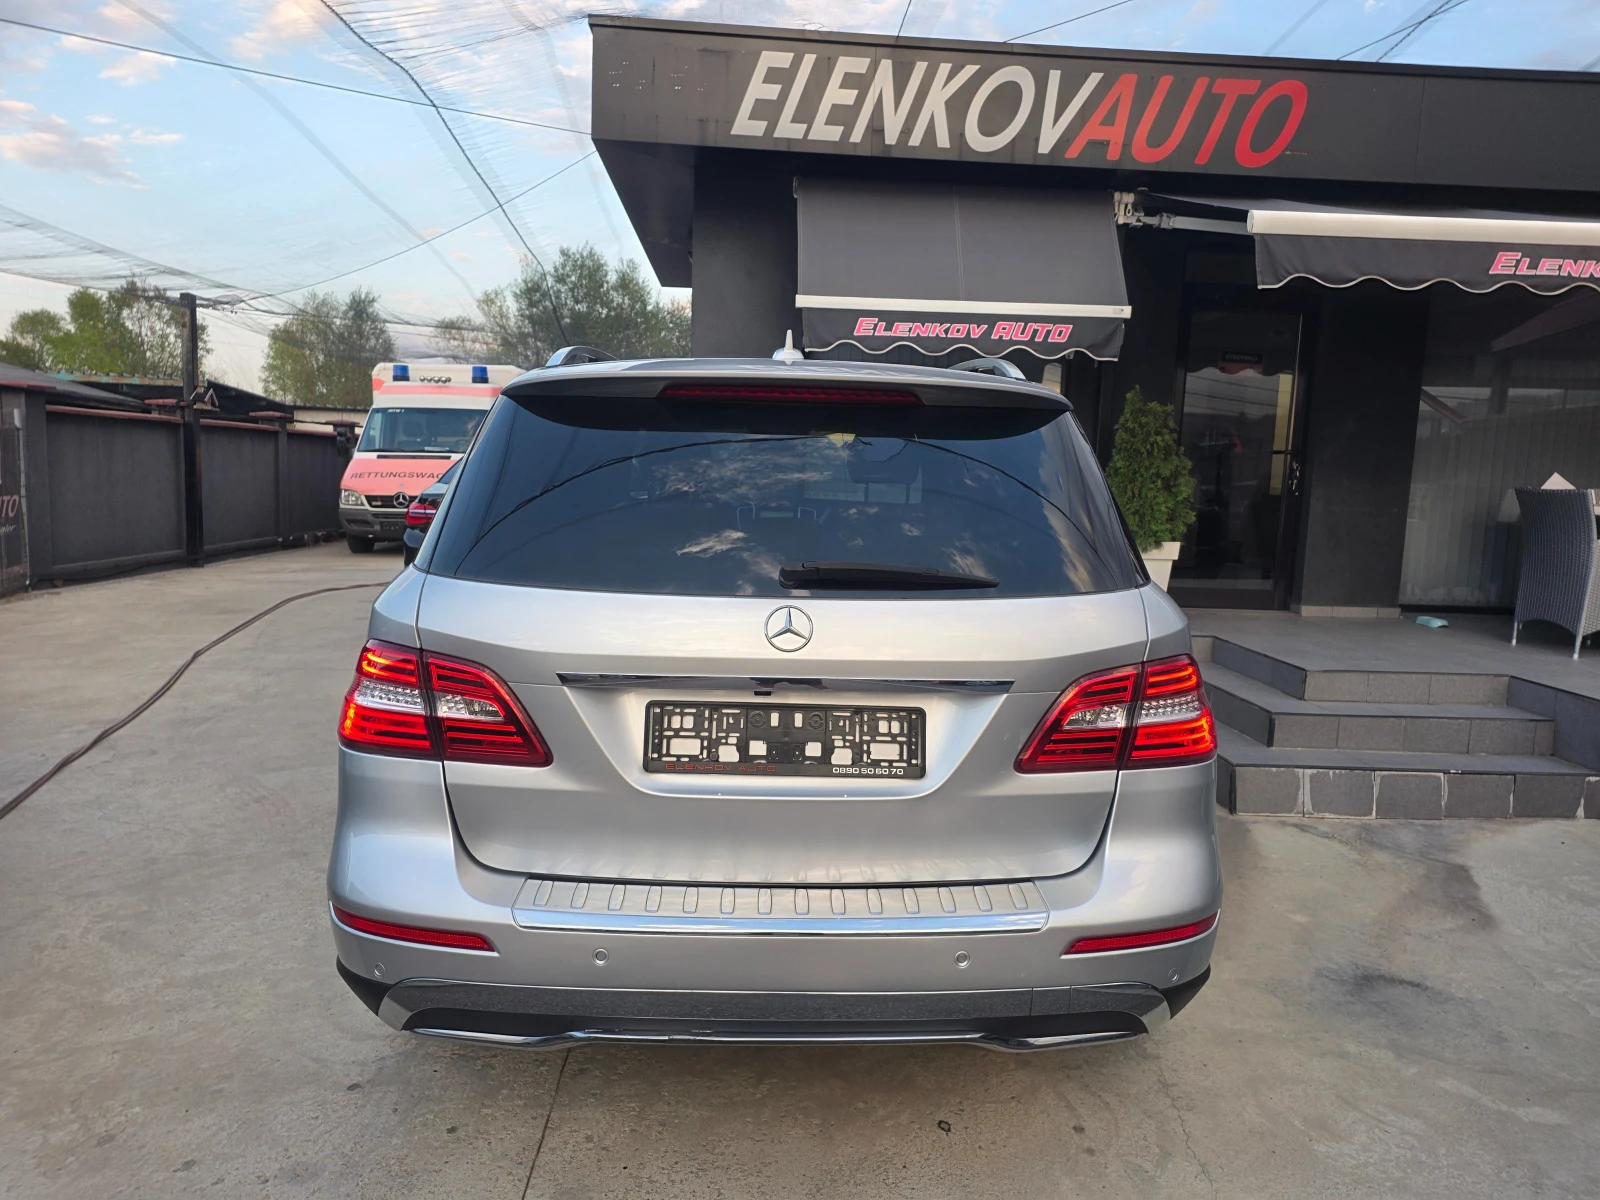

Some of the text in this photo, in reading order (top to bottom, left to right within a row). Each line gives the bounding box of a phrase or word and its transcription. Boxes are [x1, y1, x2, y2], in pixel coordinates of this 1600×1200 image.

[853, 317, 1073, 343] ELENKOV AUTO
[0, 494, 19, 518] TO
[665, 763, 733, 771] ELENKOV
[832, 767, 860, 775] 0890
[861, 767, 874, 775] 50
